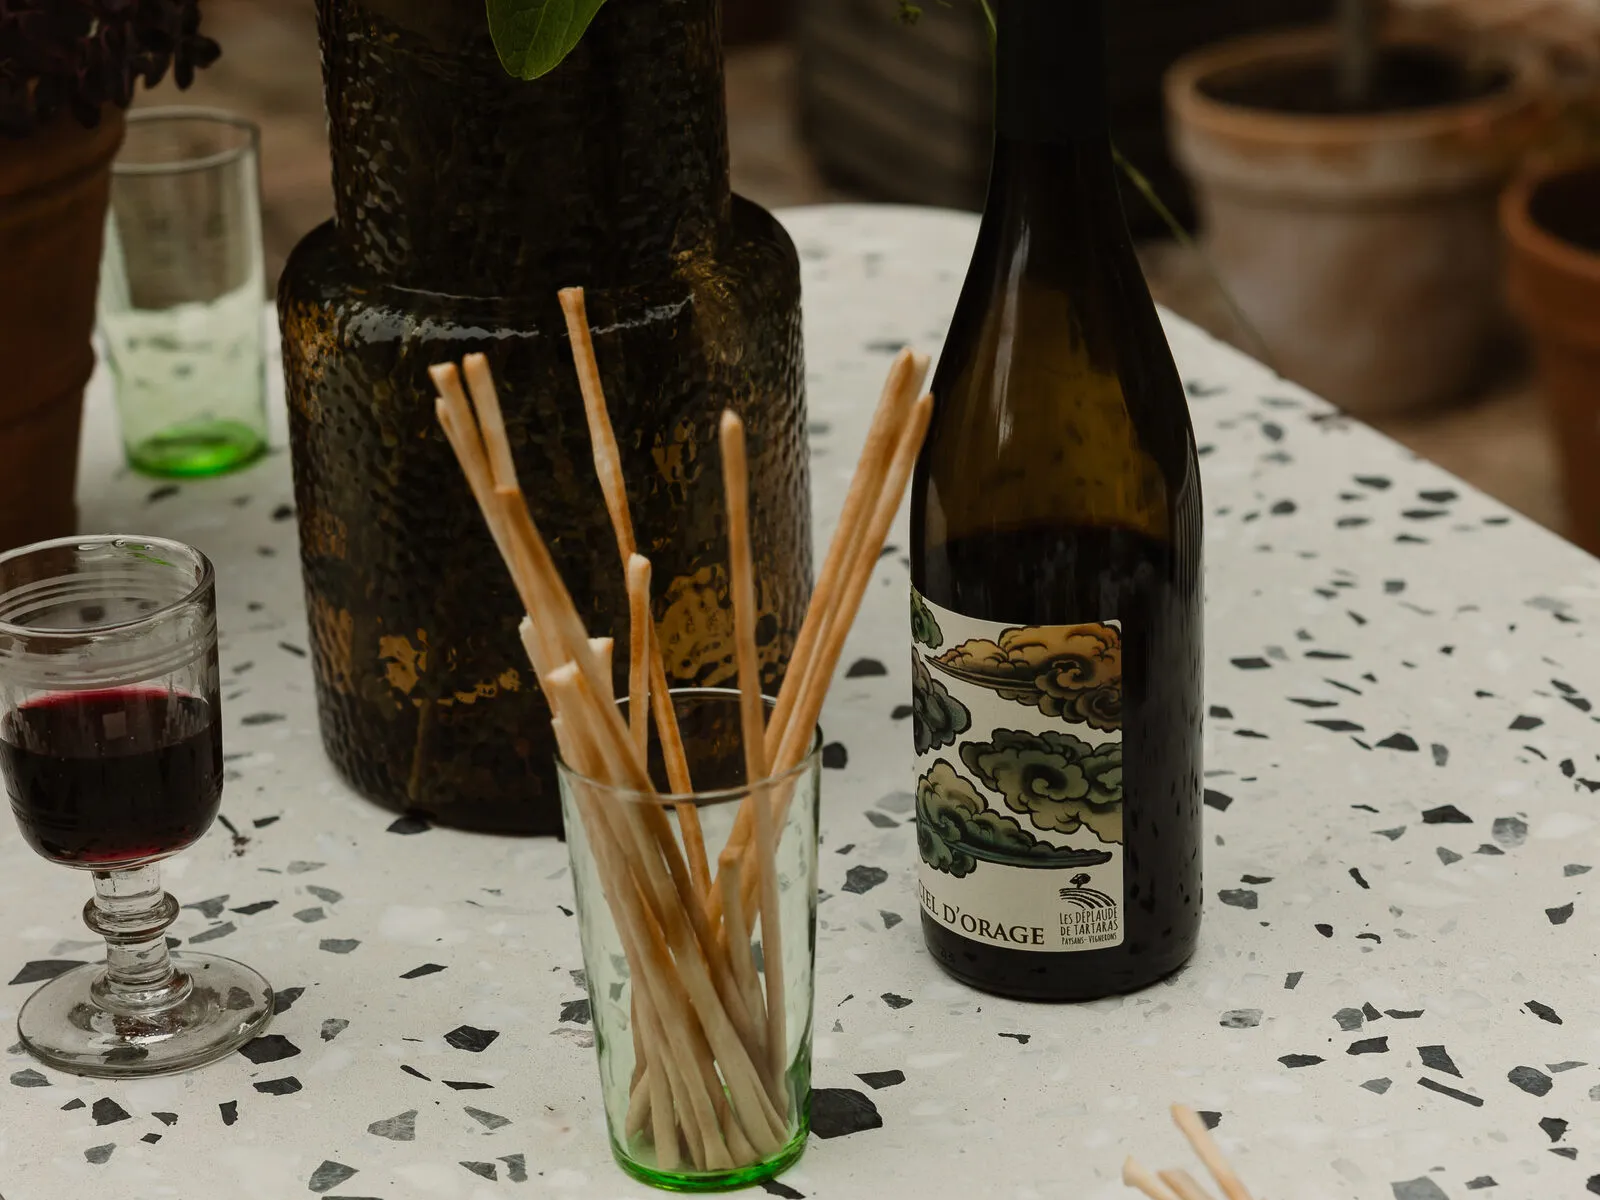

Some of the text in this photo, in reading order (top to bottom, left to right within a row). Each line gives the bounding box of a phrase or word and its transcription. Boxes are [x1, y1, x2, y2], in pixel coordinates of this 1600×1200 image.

[943, 903, 1045, 945] D'ORAGE
[1060, 907, 1117, 925] LES DÉPLAUDE
[1061, 919, 1119, 936] DE TARTARAS
